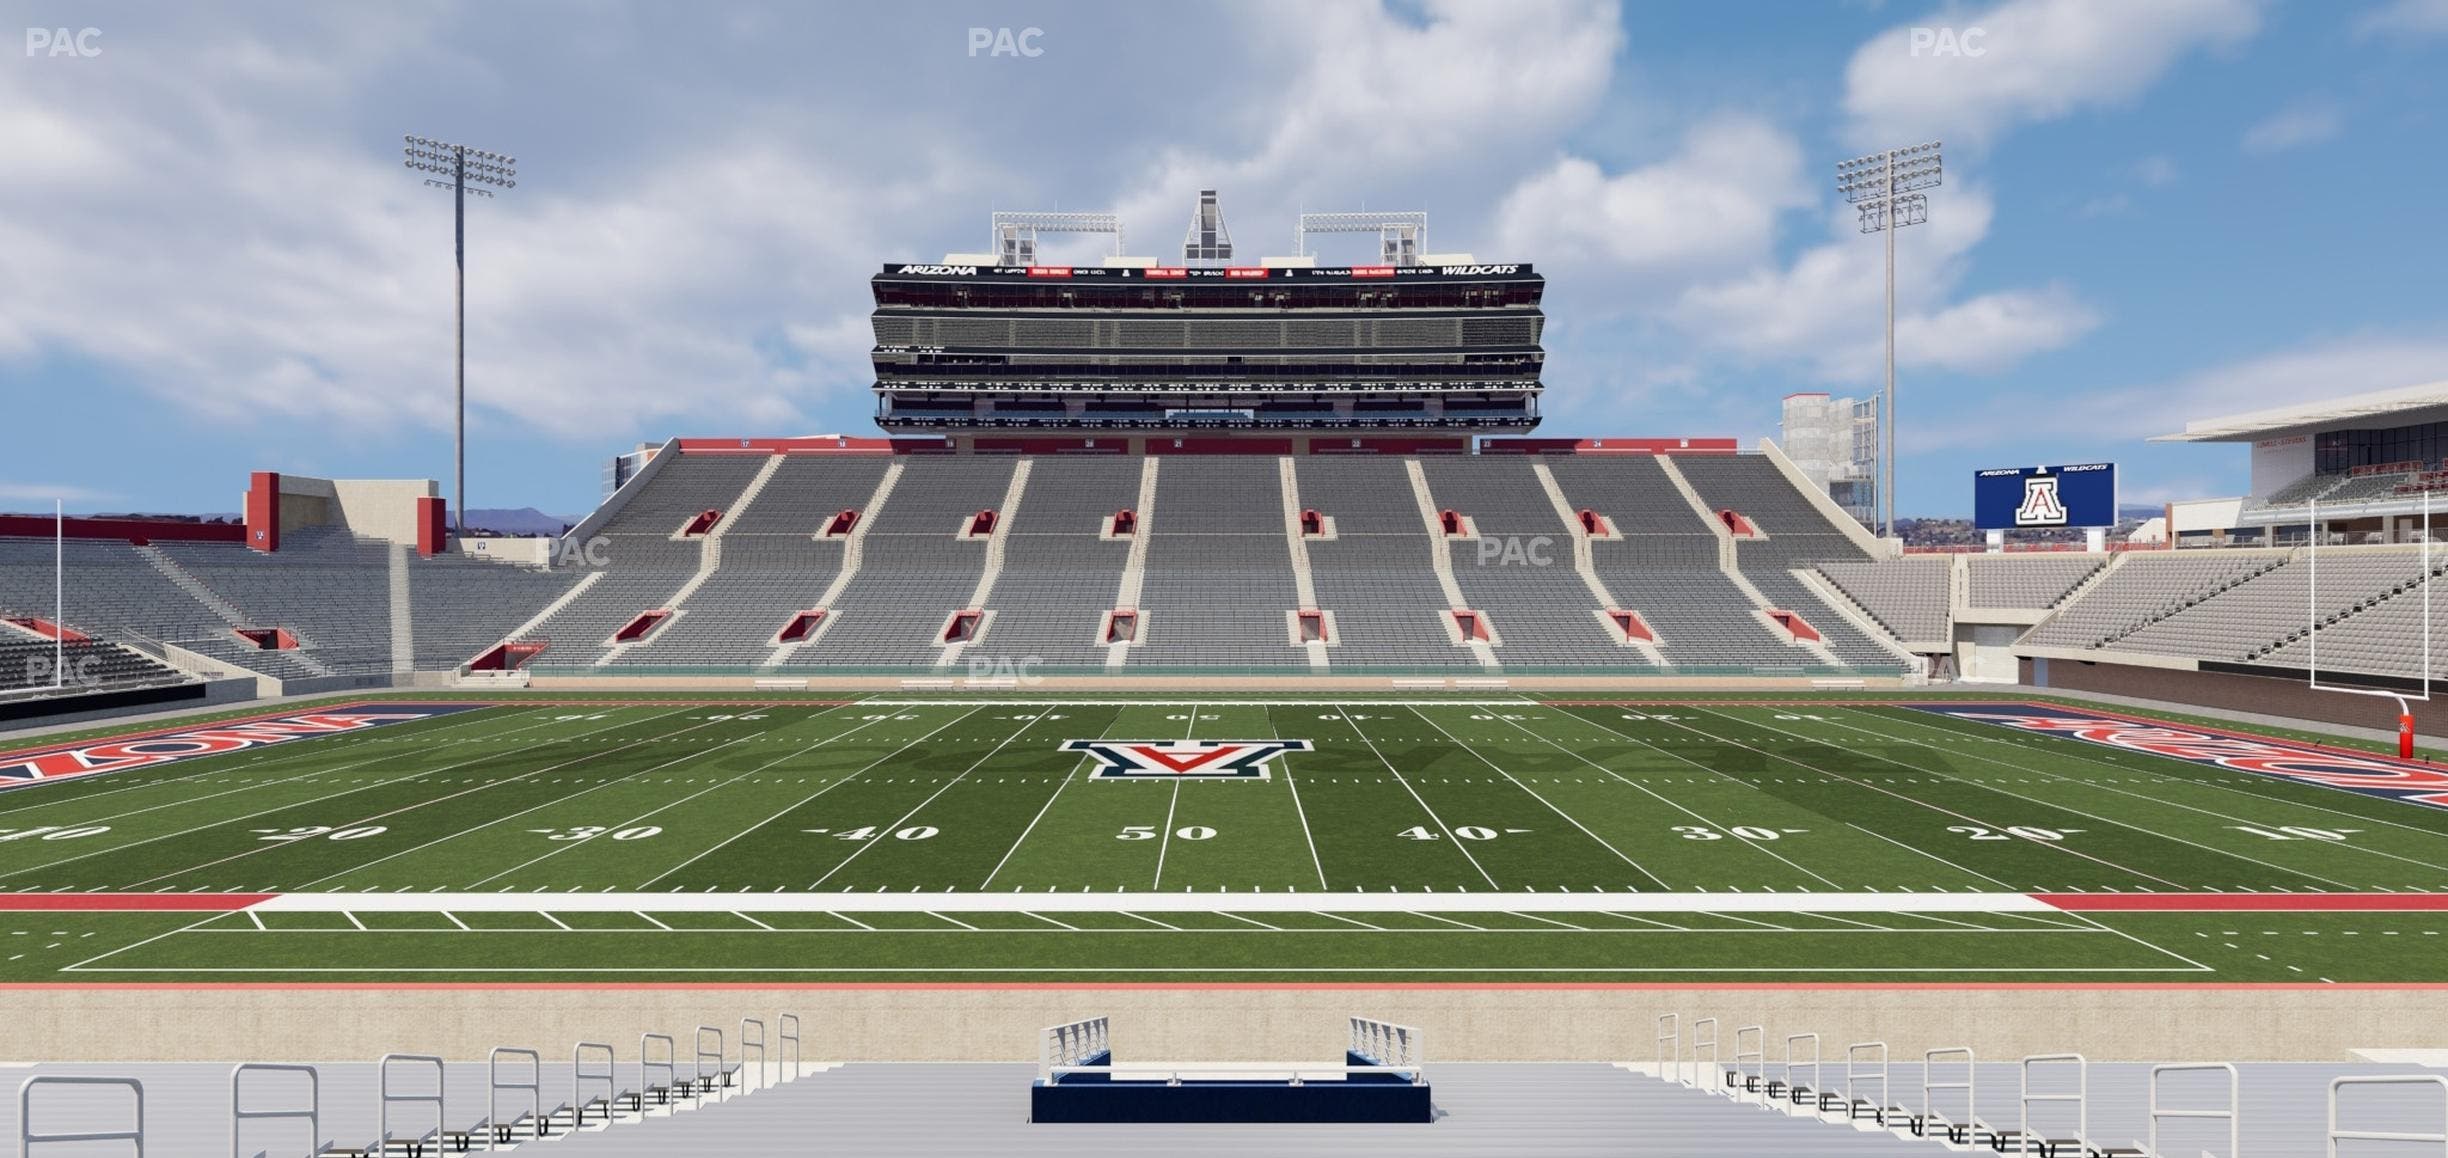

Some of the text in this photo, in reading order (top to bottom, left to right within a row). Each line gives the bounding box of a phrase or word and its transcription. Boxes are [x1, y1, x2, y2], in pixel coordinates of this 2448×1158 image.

[897, 265, 977, 276] ARIZONA
[1442, 265, 1519, 276] WILDCATS
[1979, 469, 2020, 477] ARIZONA
[2063, 464, 2108, 472] WILDCATS
[2015, 477, 2068, 526] A
[1057, 739, 1316, 780] A
[257, 826, 388, 841] 20
[547, 826, 664, 841] 30
[832, 826, 940, 841] 40
[1115, 826, 1218, 841] 50
[1396, 826, 1499, 841] 40
[1670, 826, 1781, 841] 30
[1946, 826, 2065, 841] 20
[2222, 826, 2347, 841] 10
